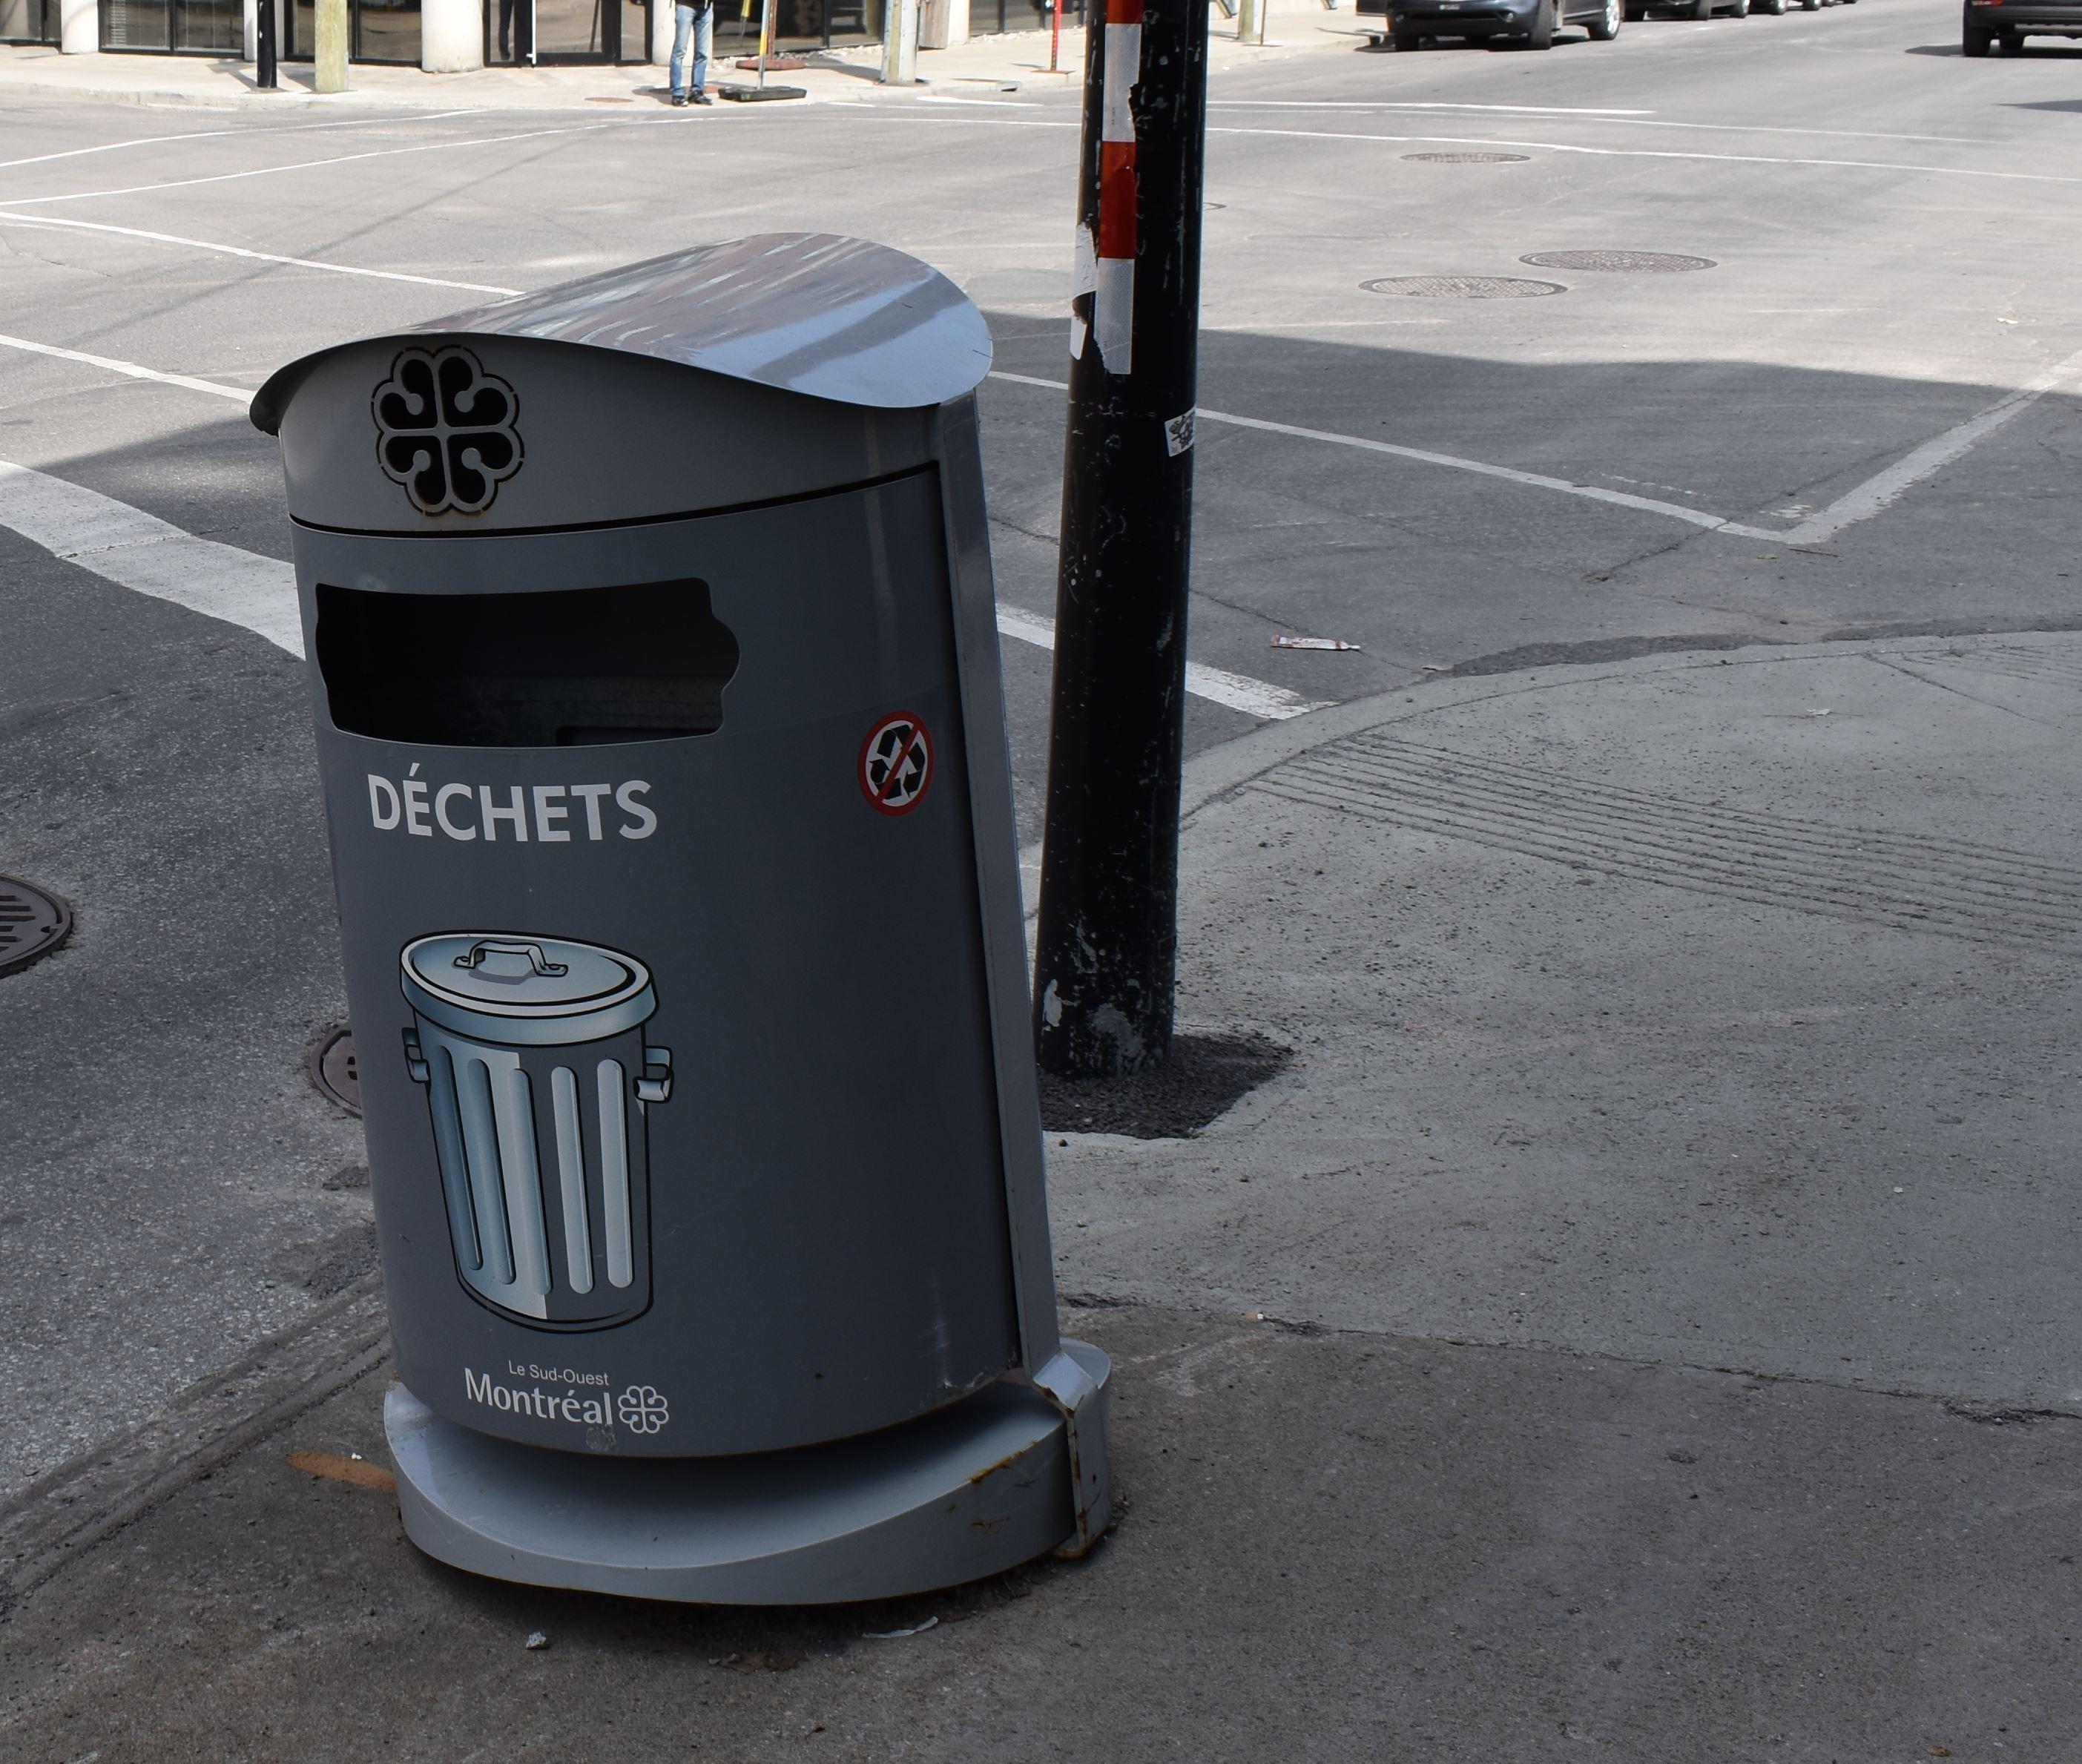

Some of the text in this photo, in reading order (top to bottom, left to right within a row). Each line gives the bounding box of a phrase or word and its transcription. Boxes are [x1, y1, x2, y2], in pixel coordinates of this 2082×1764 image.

[368, 763, 658, 842] DÉCHETS
[464, 1367, 613, 1425] Montréal
[508, 1360, 610, 1386] Le Sud-Ouest
